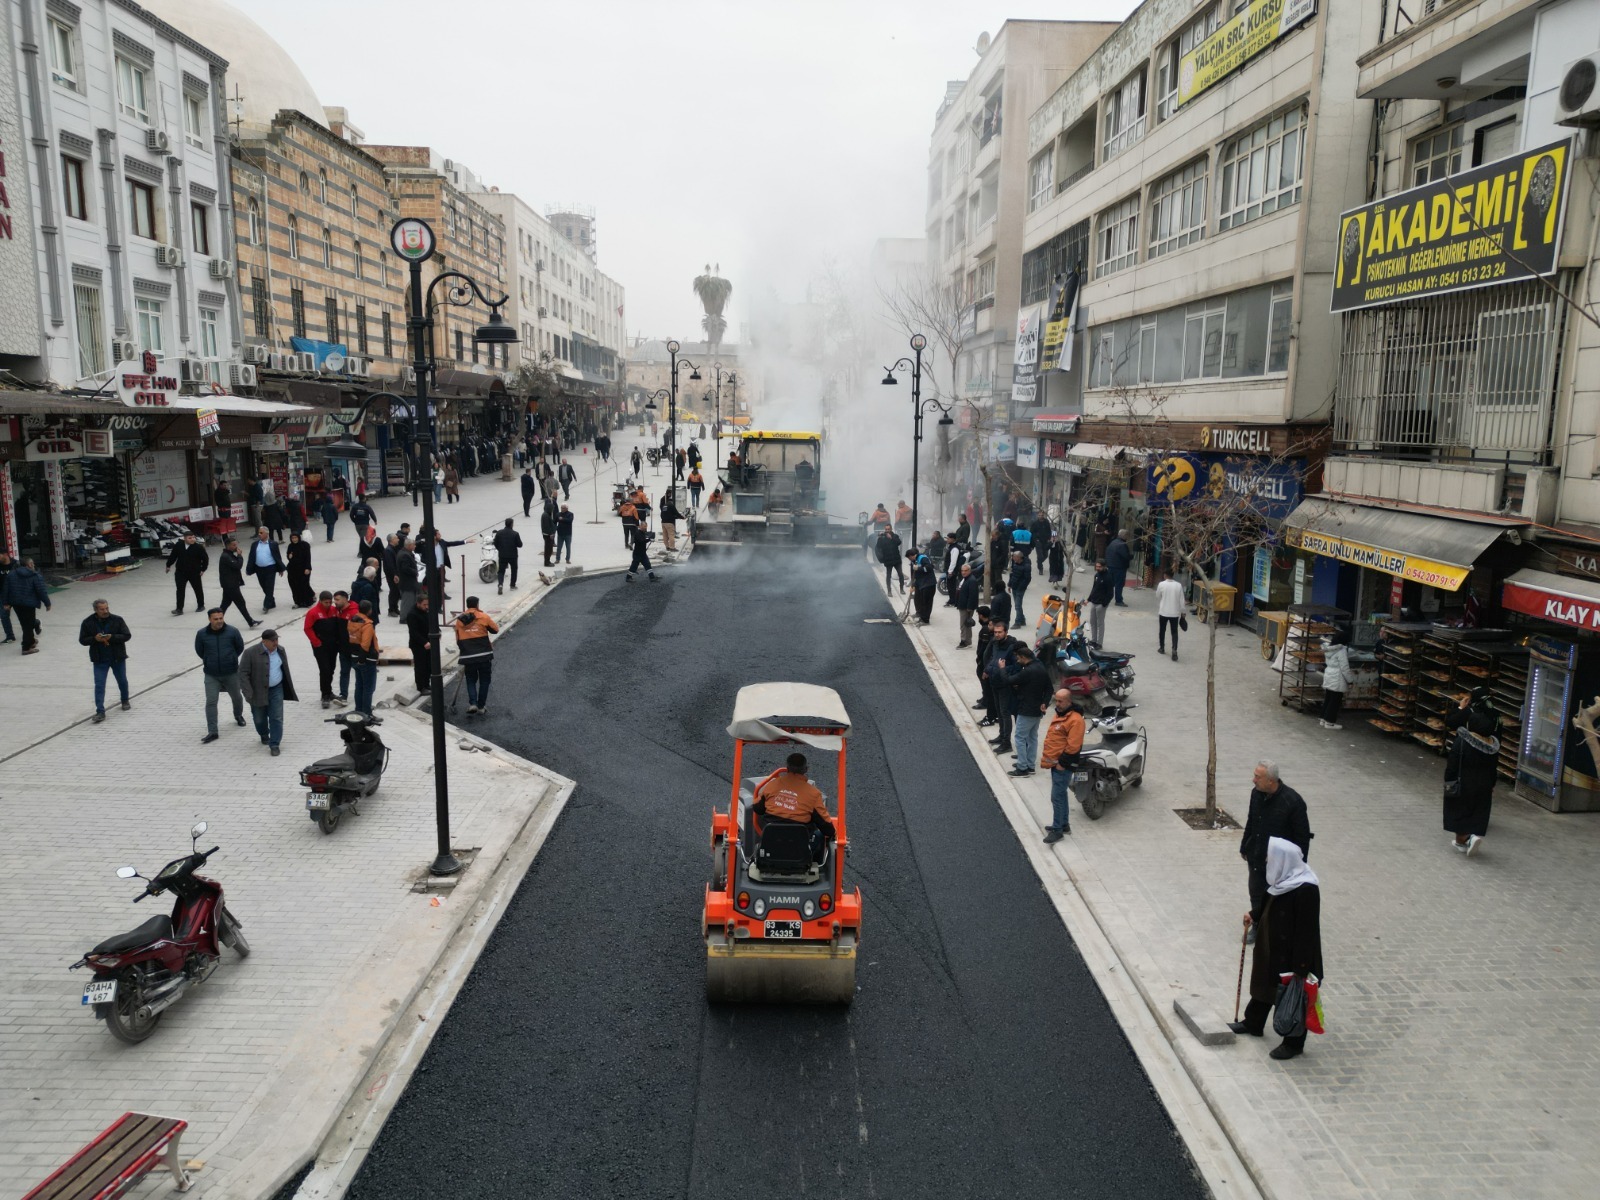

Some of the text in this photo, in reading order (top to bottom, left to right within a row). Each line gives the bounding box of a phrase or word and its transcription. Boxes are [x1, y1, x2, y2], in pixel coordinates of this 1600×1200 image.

[1195, 39, 1225, 73] YALÇIN
[1226, 22, 1245, 50] SRC
[1247, 0, 1282, 36] KURSU
[1367, 227, 1504, 283] PSİKOTEKNİK DEĞERLENDİRME MERKEZİ
[1364, 261, 1506, 301] KURUCU HASAN AY: 0541 613 23 24
[134, 391, 170, 406] OTEL
[37, 440, 75, 454] OTEL
[1212, 428, 1271, 451] TURKCELL
[1225, 472, 1288, 501] TURKCELL
[1353, 547, 1406, 574] MAMÜLLERİ
[1412, 569, 1426, 580] 542
[1425, 572, 1440, 583] 207
[1440, 575, 1449, 586] 91
[1545, 599, 1590, 625] KLAY
[769, 896, 800, 904] HAMM
[766, 921, 801, 929] 63 KS
[770, 929, 794, 937] 24335
[85, 982, 113, 993] 63AHA
